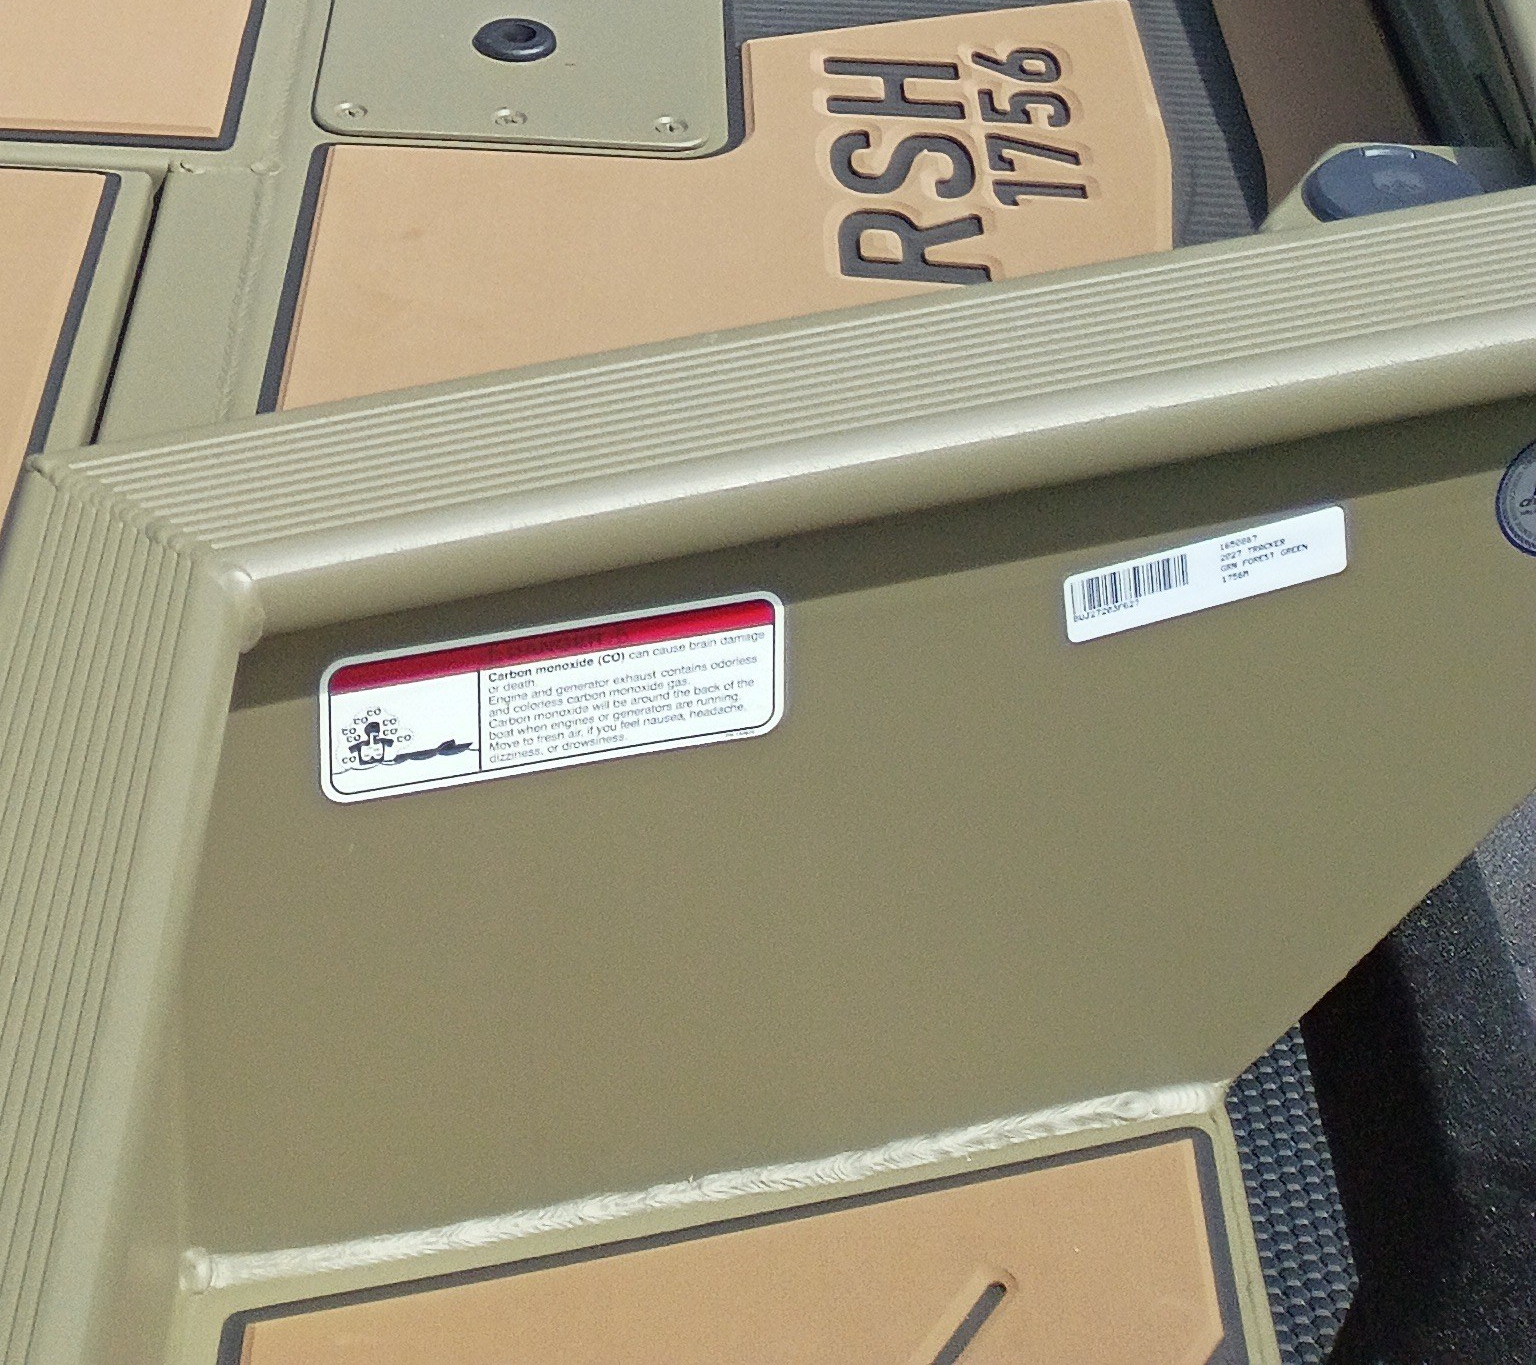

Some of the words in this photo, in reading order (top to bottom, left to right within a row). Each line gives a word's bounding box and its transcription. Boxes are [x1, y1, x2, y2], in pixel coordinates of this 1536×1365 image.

[971, 47, 1089, 207] 1756
[823, 56, 994, 286] RSH
[1242, 551, 1275, 566] FOREST
[1280, 543, 1309, 557] GREEN
[1248, 538, 1286, 554] TRACKER
[488, 669, 533, 683] Carbon
[535, 657, 594, 675] monoxide
[597, 651, 626, 667] (CO)
[628, 649, 650, 661] can
[652, 643, 686, 657] cause
[689, 637, 717, 651] brain
[720, 631, 765, 646] damage
[488, 692, 528, 707] Engine
[531, 686, 553, 699] and
[555, 678, 610, 696] generator
[613, 671, 657, 686] exhaust
[660, 663, 708, 678] contains
[710, 655, 758, 670] odorless
[488, 685, 499, 695] or
[488, 705, 510, 718] and
[513, 699, 563, 714] colorless
[566, 690, 607, 705] carbon
[609, 680, 664, 697] monoxide
[488, 715, 531, 729] Carbon
[533, 704, 590, 722] monoxide
[592, 699, 610, 711] will
[613, 698, 627, 710] be
[631, 691, 670, 705] around
[673, 688, 691, 699] the
[693, 683, 720, 696] back
[723, 680, 735, 691] of
[737, 678, 755, 689] the
[489, 728, 515, 741] boat
[517, 722, 548, 735] when
[550, 715, 595, 732] engines
[598, 713, 610, 722] or
[612, 703, 673, 723] generators
[675, 700, 694, 710] are
[489, 740, 520, 753] Move
[522, 737, 534, 746] to
[536, 730, 565, 744] fresh
[587, 725, 593, 735] if
[596, 723, 617, 737] you
[620, 717, 640, 730] feel
[489, 746, 544, 764] dizziness,
[547, 743, 558, 754] or
